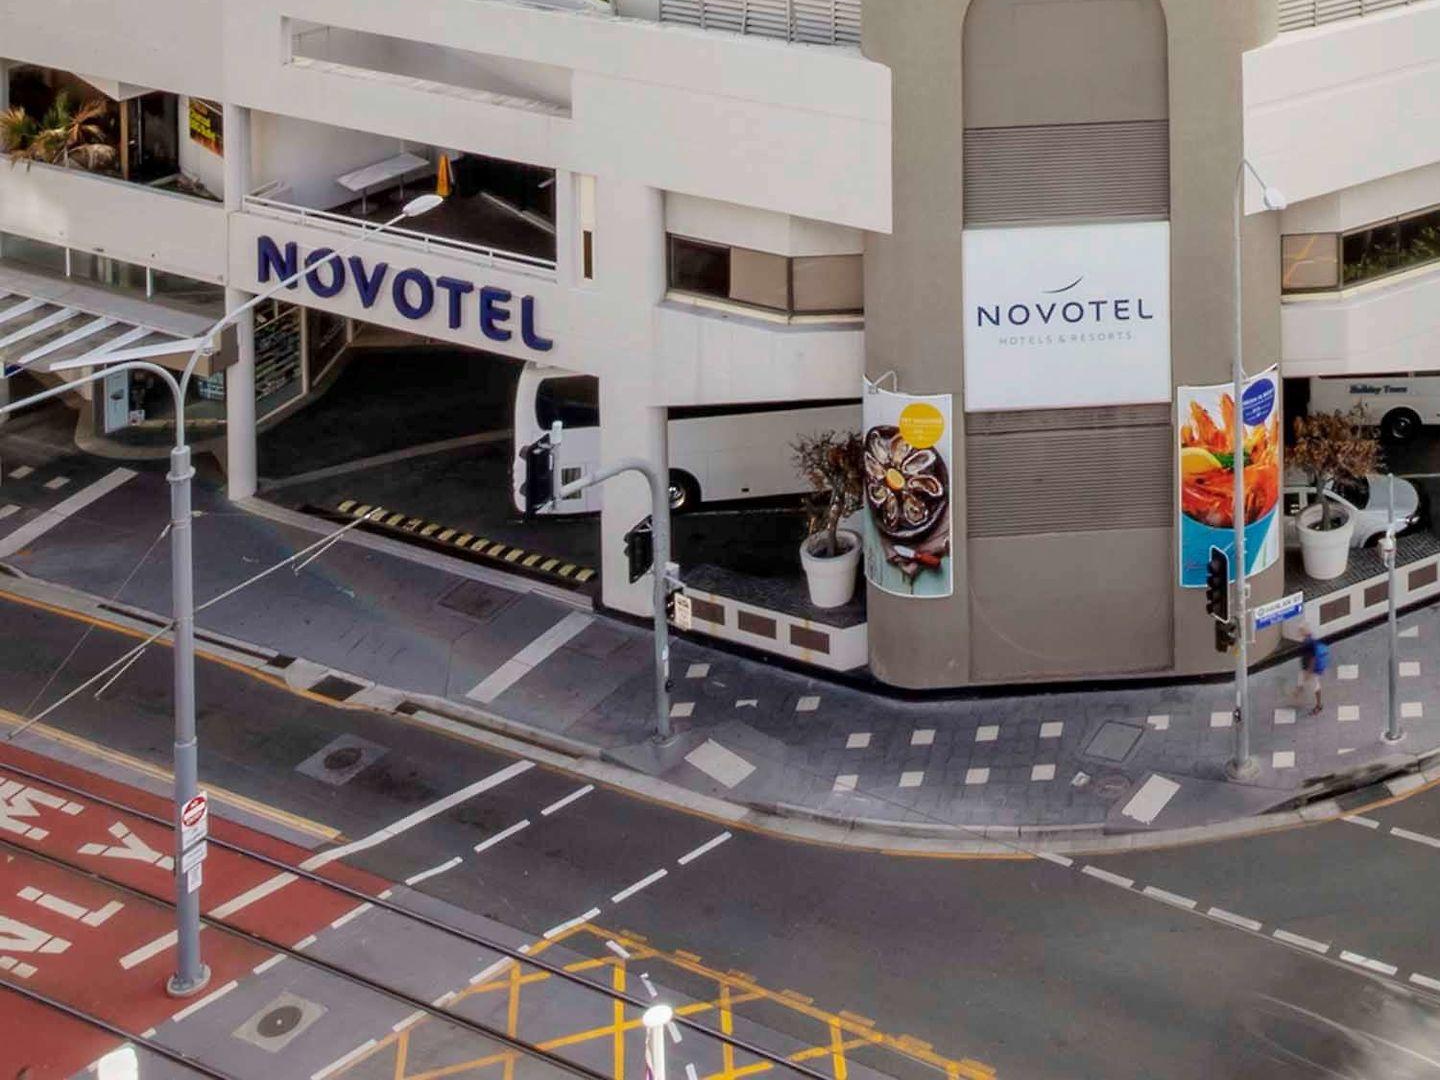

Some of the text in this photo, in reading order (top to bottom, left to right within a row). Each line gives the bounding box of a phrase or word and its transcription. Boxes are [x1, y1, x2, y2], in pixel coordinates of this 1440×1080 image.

[257, 234, 553, 352] NOVOTEL
[976, 298, 1153, 327] NOVOTEL
[1000, 330, 1133, 346] HOTELS & RESORTS
